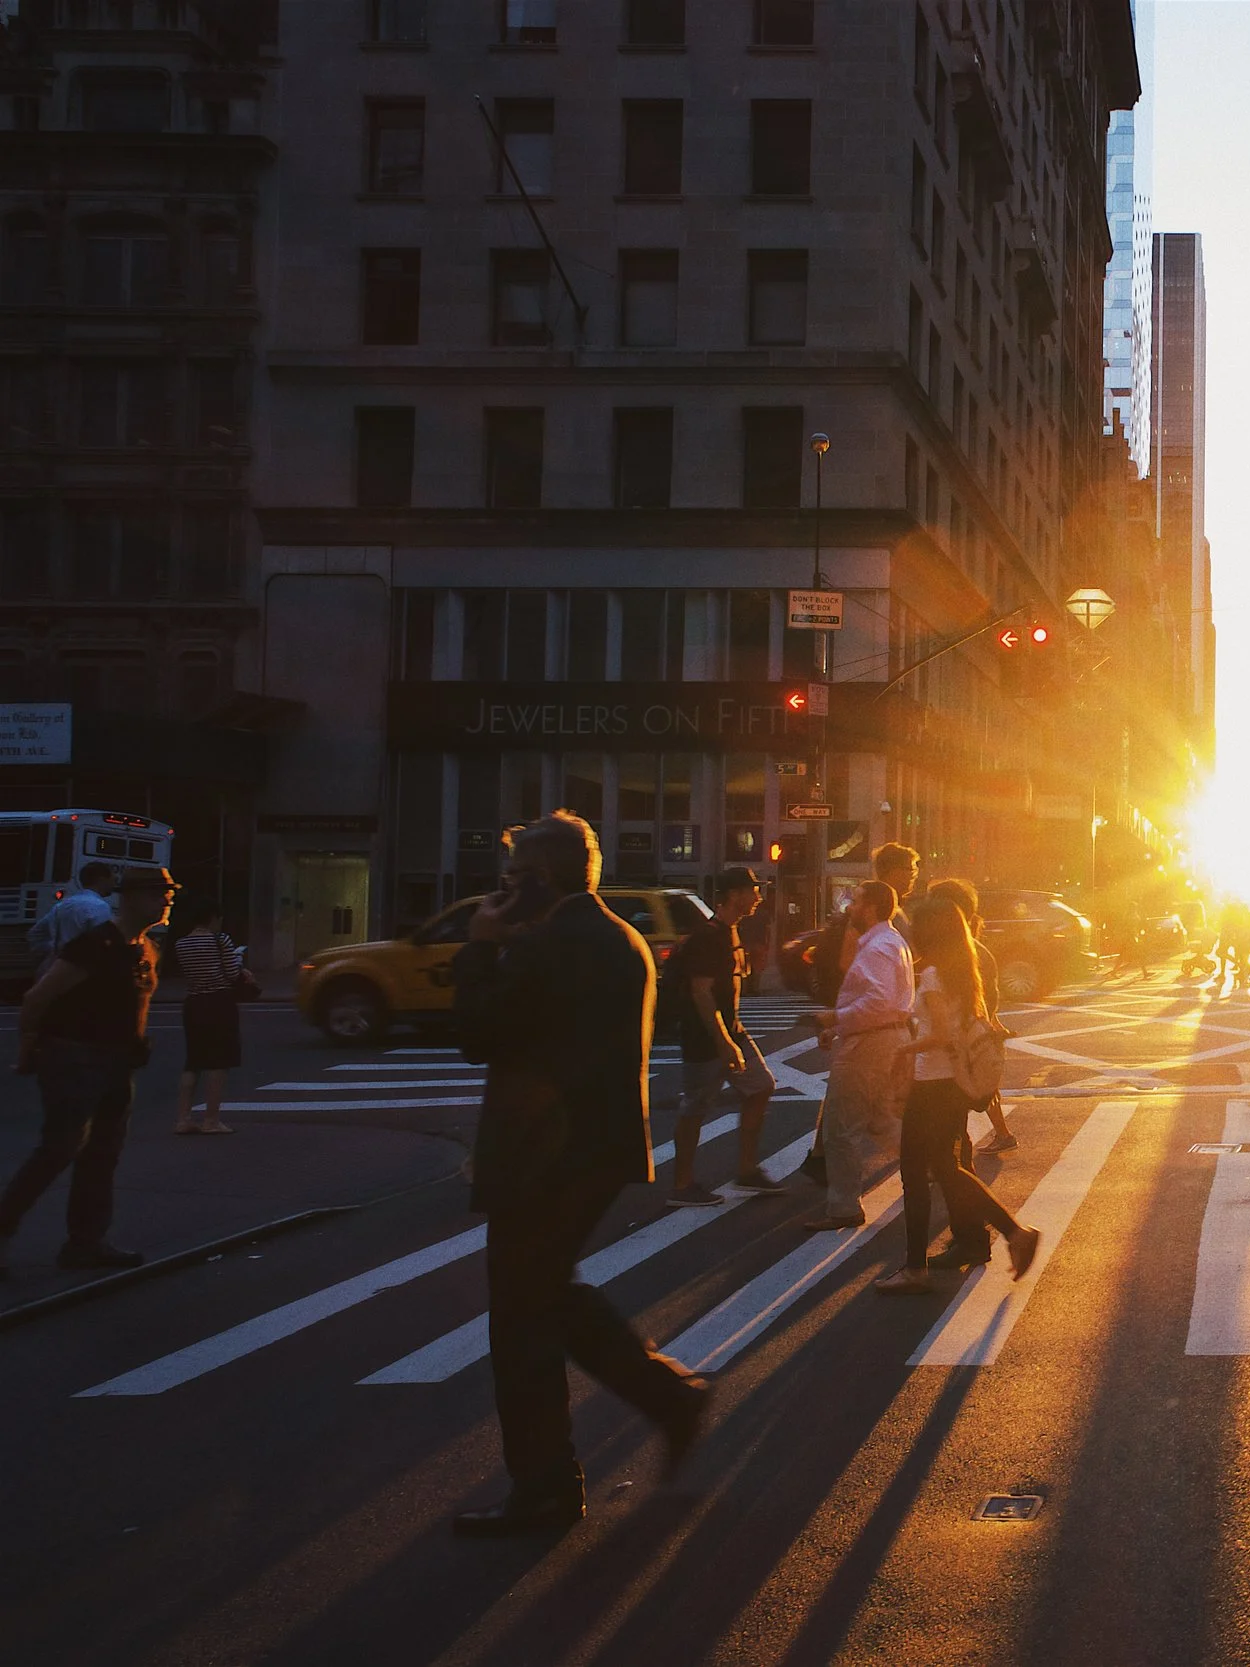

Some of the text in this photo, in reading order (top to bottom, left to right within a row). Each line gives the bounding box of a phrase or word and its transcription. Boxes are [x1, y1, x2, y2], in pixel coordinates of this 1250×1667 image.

[792, 595, 814, 603] DON'T
[465, 698, 628, 735] JEWELERS
[643, 704, 700, 735] ON
[777, 764, 785, 774] 5
